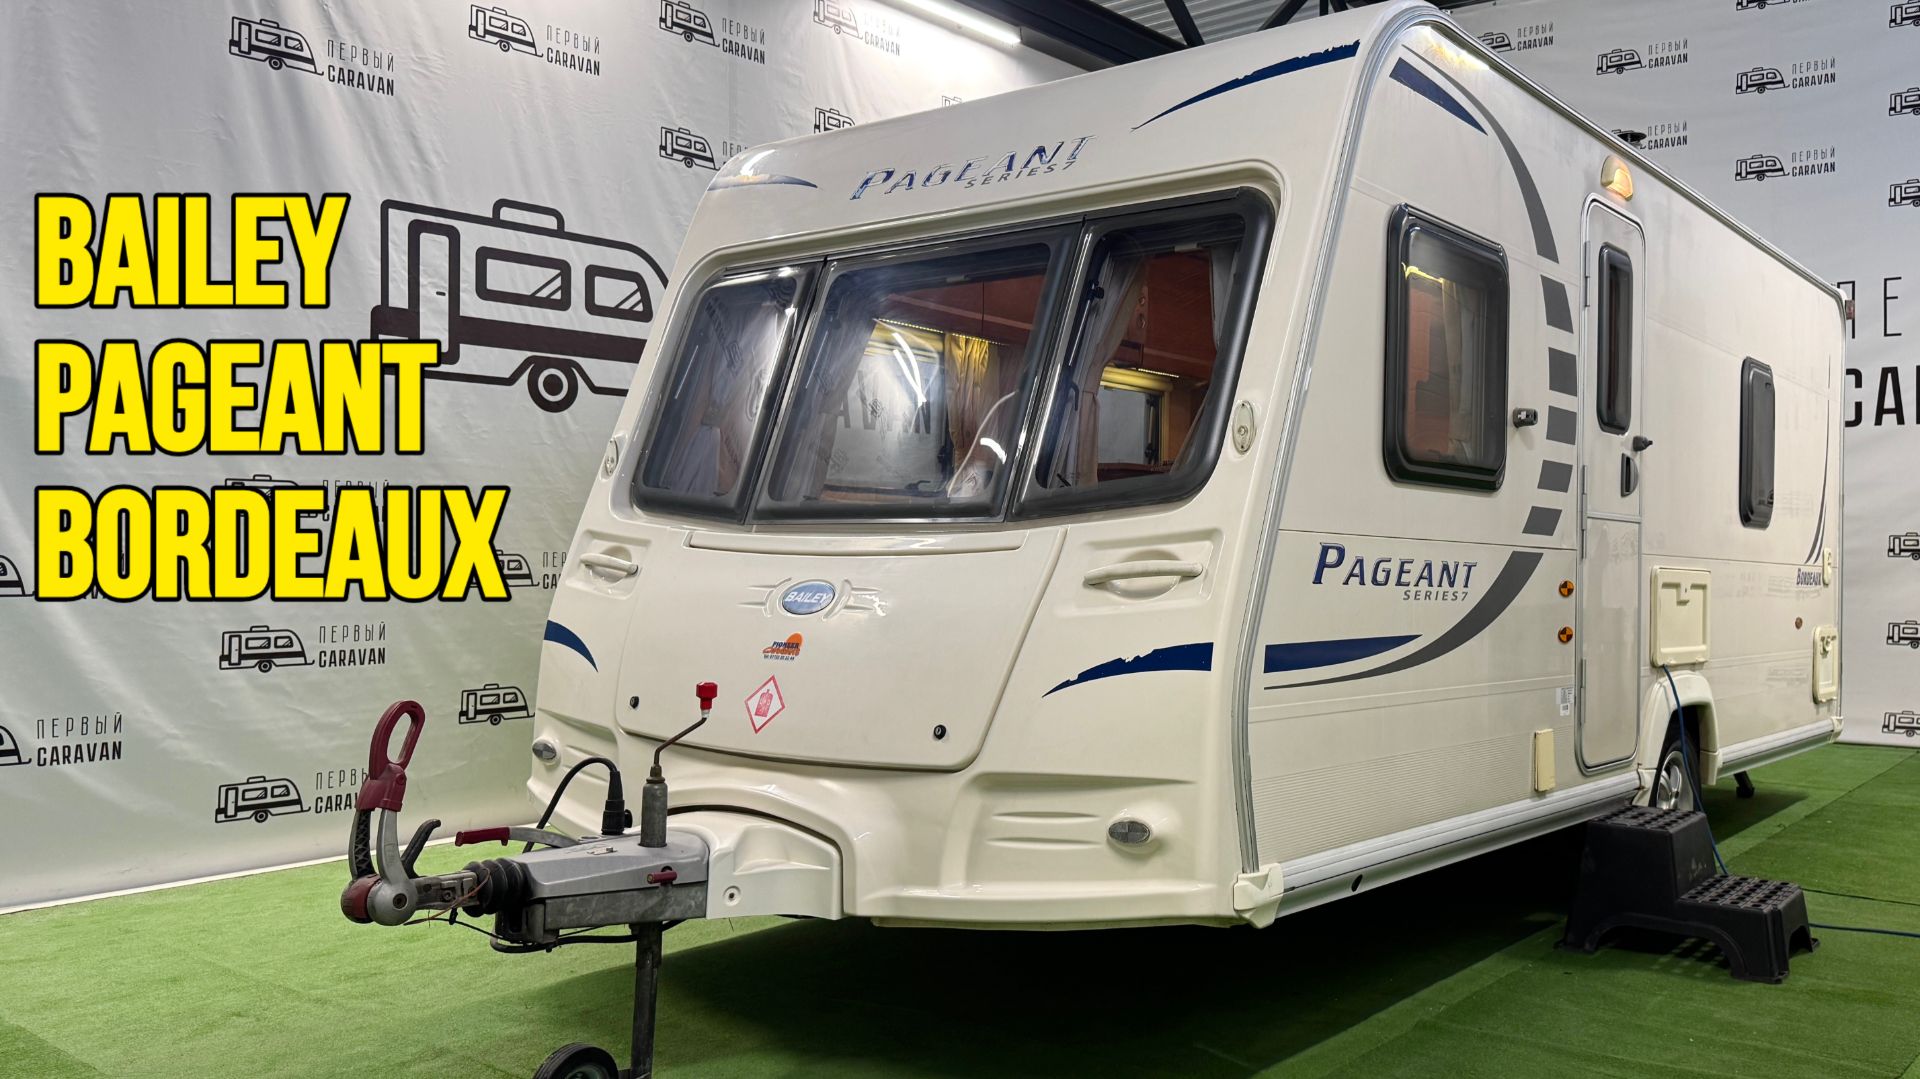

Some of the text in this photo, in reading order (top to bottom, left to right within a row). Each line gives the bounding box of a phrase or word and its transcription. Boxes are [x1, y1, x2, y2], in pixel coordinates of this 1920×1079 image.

[546, 24, 600, 54] ПЕРВЫЙ
[722, 17, 765, 45] ПЕРВЫЙ
[1517, 21, 1554, 39] ПЕРВЫЙ
[722, 38, 766, 65] CARAVAN
[1517, 35, 1554, 51] CARAVAN
[1648, 38, 1688, 56] ПЕРВЫЙ
[327, 40, 395, 73] ПЕРВЫЙ
[546, 47, 601, 76] CARAVAN
[1648, 52, 1688, 69] CARAVAN
[1791, 56, 1836, 75] ПЕРВЫЙ
[327, 64, 395, 97] CARAVAN
[1792, 72, 1836, 89] CARAVAN
[1647, 121, 1687, 137] ПЕРВЫЙ
[1647, 135, 1688, 150] CARAVAN
[1791, 146, 1836, 163] ПЕРВЫЙ
[850, 134, 1098, 201] PAGEANT
[1791, 161, 1836, 178] CARAVAN
[542, 551, 567, 568] ПЕР
[1312, 541, 1478, 588] PAGEANT
[785, 591, 833, 604] BAILEY
[319, 621, 386, 644] ПЕРВЫЙ
[318, 647, 386, 668] CARAVAN
[37, 711, 122, 740] ПЕРВЫЙ
[37, 740, 122, 767] CARAVAN
